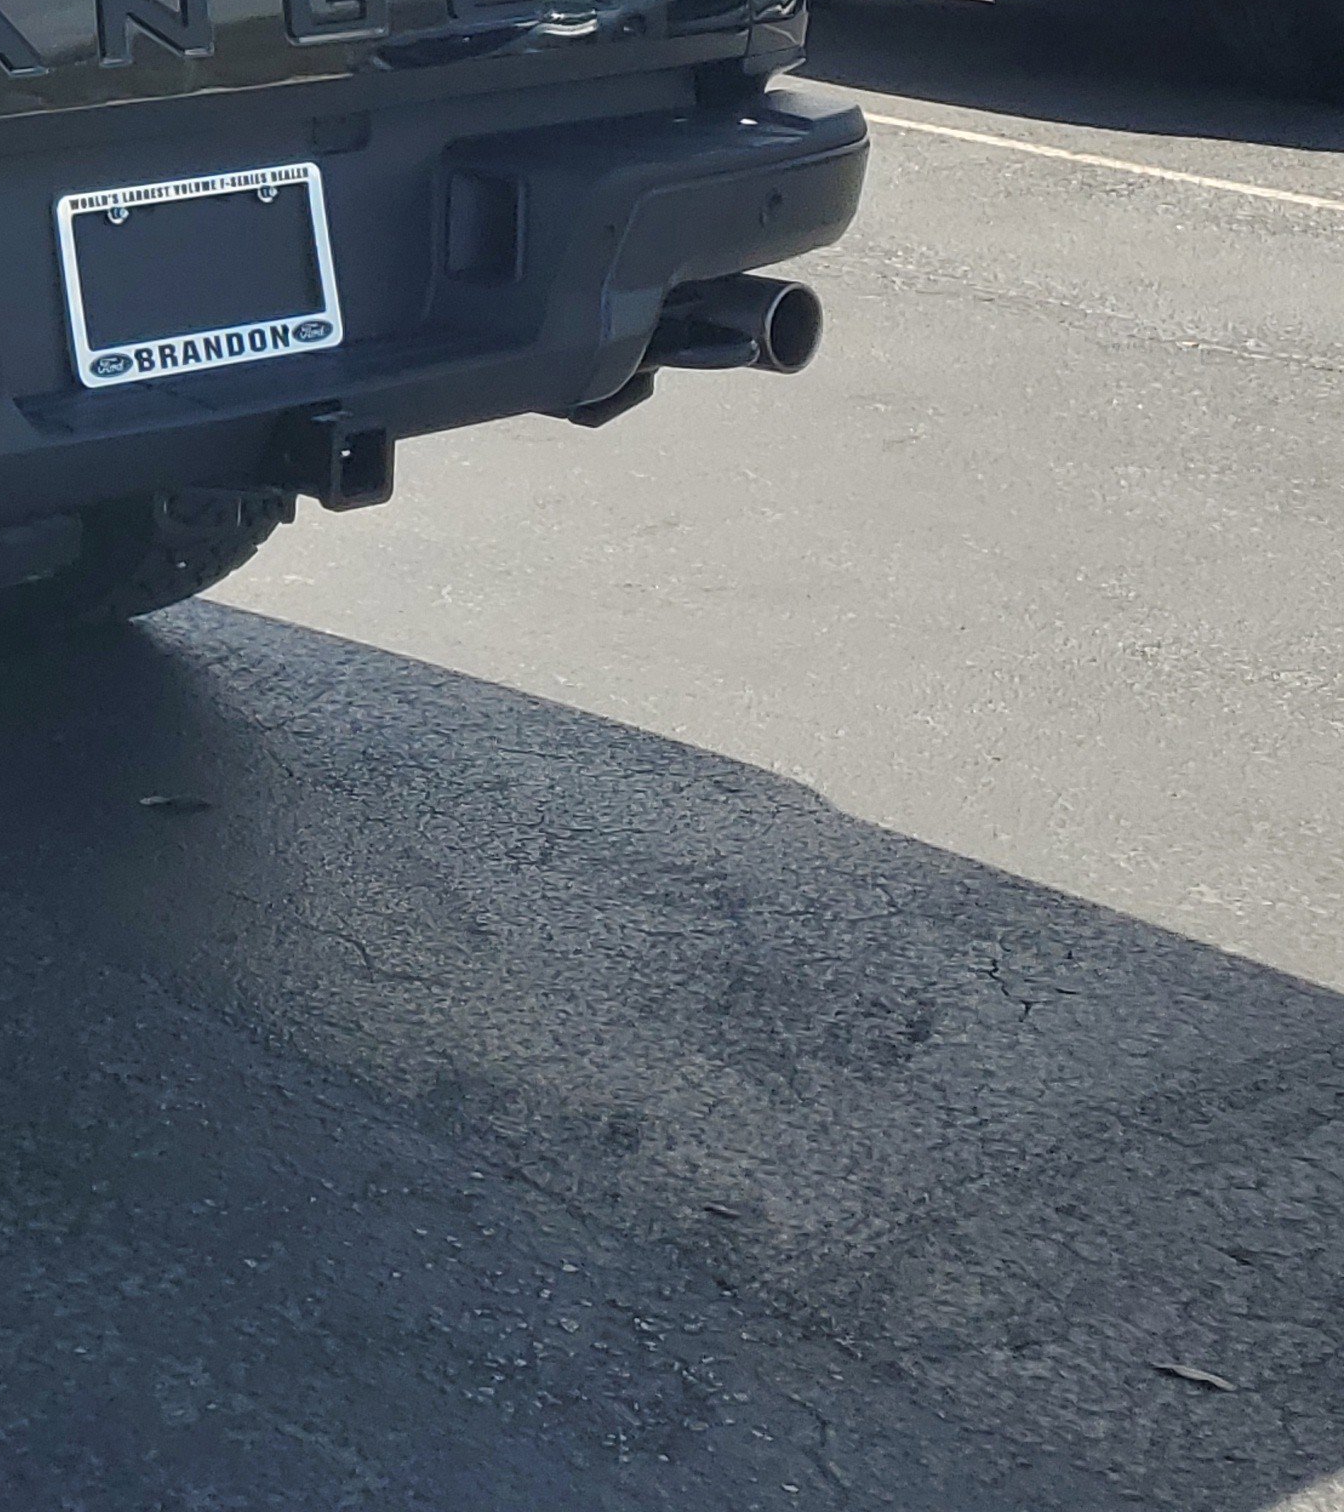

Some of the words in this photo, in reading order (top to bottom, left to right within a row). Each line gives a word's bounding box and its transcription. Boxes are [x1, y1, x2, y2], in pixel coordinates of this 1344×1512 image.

[69, 192, 119, 209] WORLD'S
[122, 185, 170, 203] LARGEST
[174, 179, 216, 196] VOLUME
[219, 172, 267, 190] F-SERIES
[270, 167, 309, 183] DEALER
[134, 324, 290, 373] BRANDON
